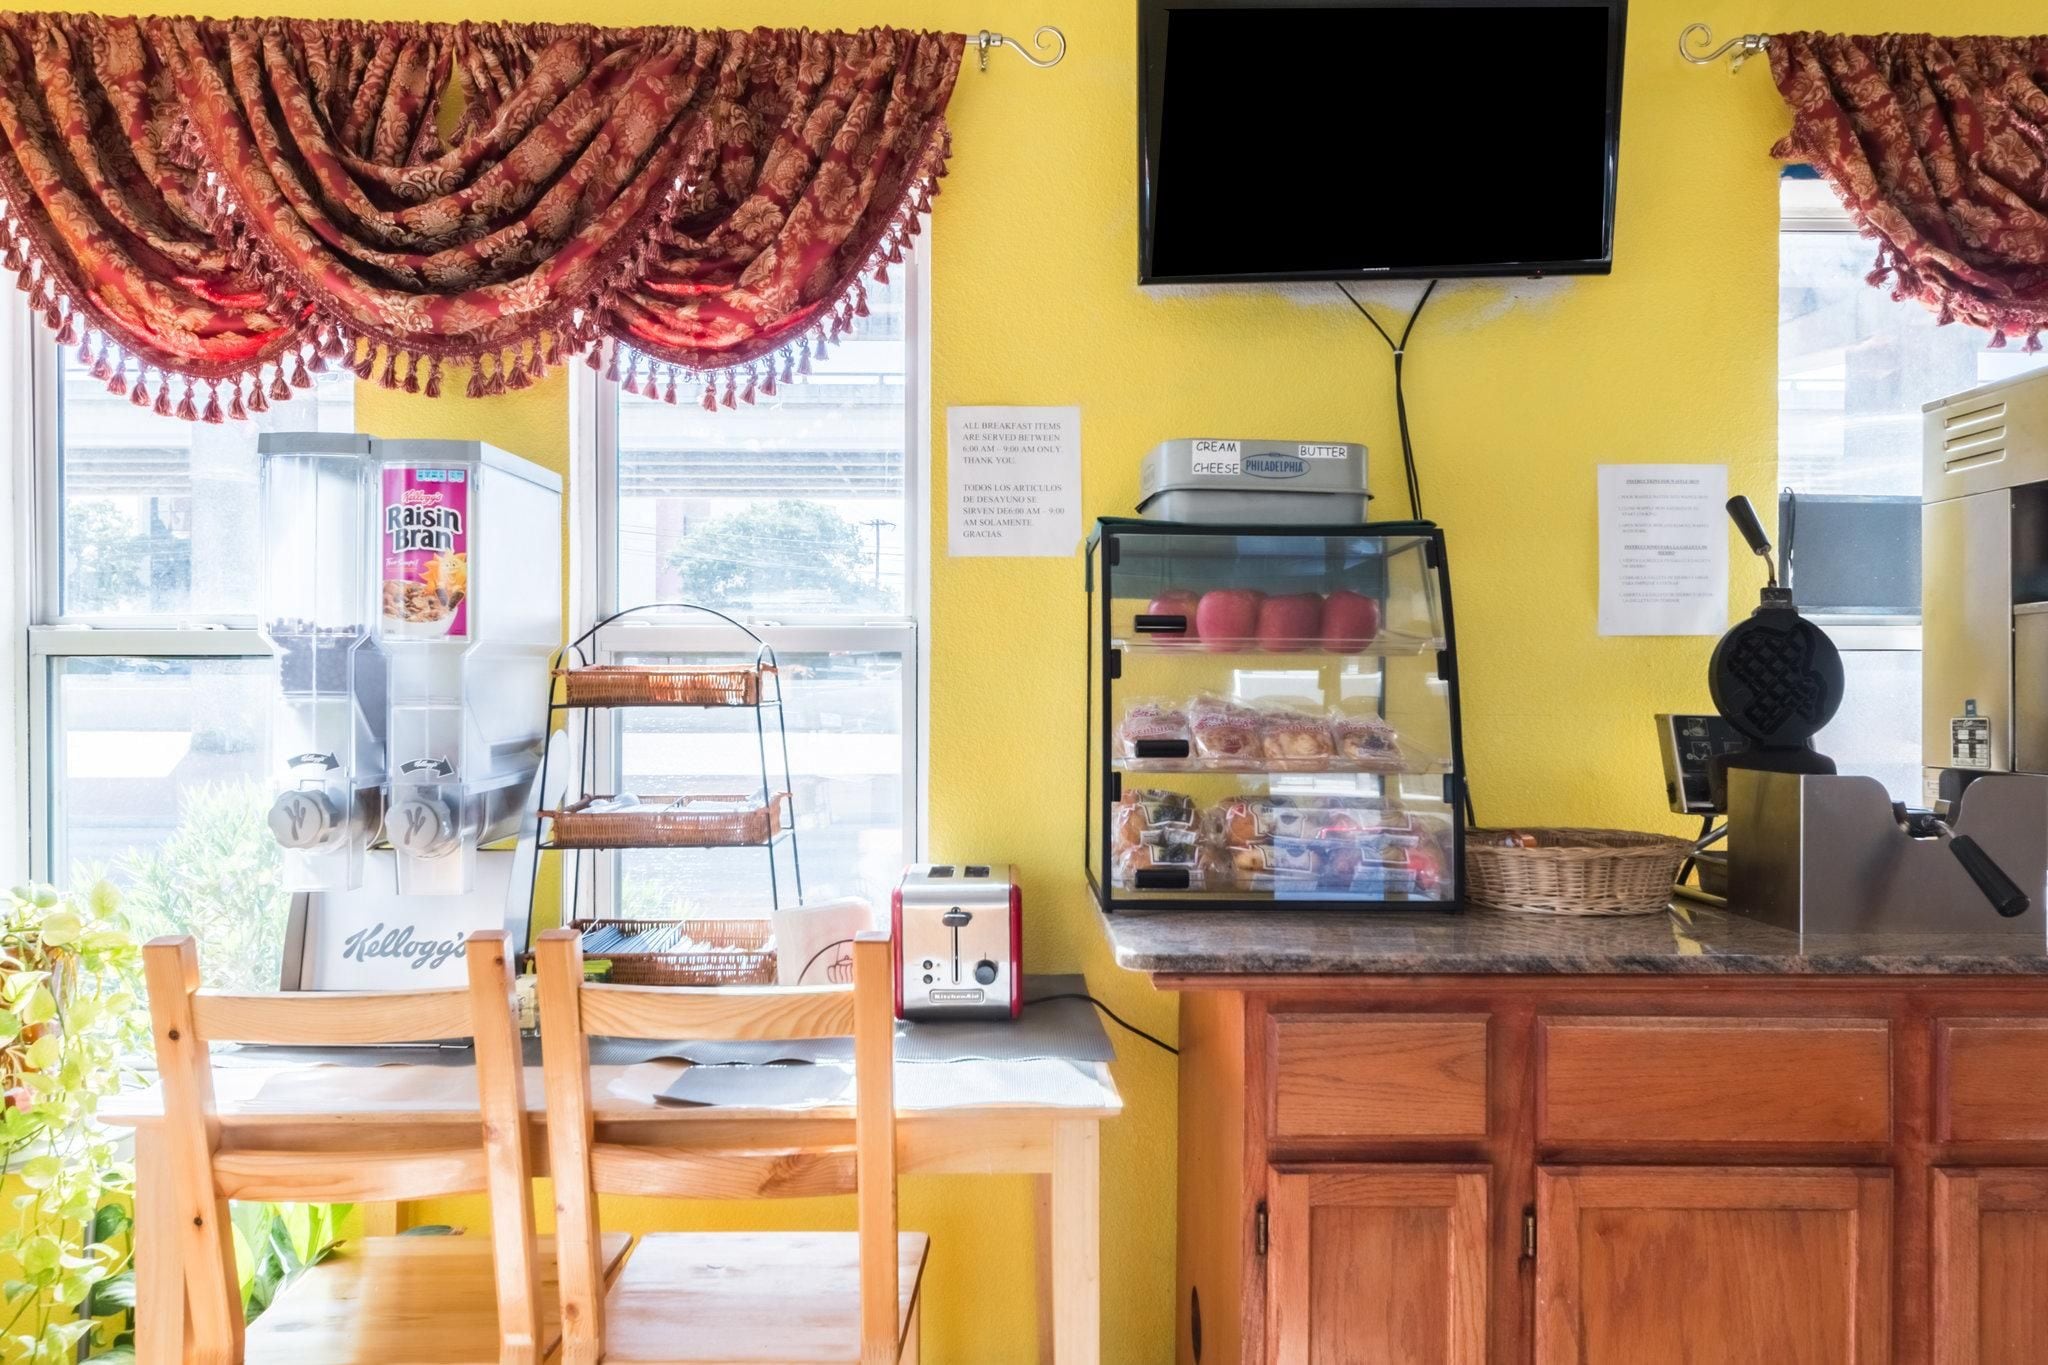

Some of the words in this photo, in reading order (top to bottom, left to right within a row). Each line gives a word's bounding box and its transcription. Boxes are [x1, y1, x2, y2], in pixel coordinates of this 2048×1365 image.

[962, 422, 979, 430] ALL
[982, 422, 1033, 430] BREAKFAST
[1034, 422, 1061, 430] ITEMS
[962, 433, 980, 441] ARE
[982, 433, 1017, 441] SERVED
[1018, 433, 1060, 441] BETWEEN
[980, 445, 995, 453] AM
[1020, 445, 1035, 453] AM
[1196, 441, 1237, 453] CREAM
[1300, 446, 1346, 458] BUTTER
[963, 456, 993, 464] THANK
[1193, 463, 1239, 474] CHEESE
[1246, 460, 1304, 473] PHILADELPHIA
[963, 484, 992, 492] TODOS
[994, 484, 1011, 492] LOS
[1013, 484, 1062, 492] ARTICULOS
[401, 489, 443, 506] Kellogg's
[962, 495, 976, 503] DE
[977, 495, 1025, 503] DESAYUNO
[962, 507, 994, 515] SIRVEN
[1026, 507, 1040, 515] AM
[386, 505, 461, 533] Raisin
[963, 519, 977, 527] AM
[394, 528, 453, 551] Bran
[343, 922, 466, 970] Kellogg's
